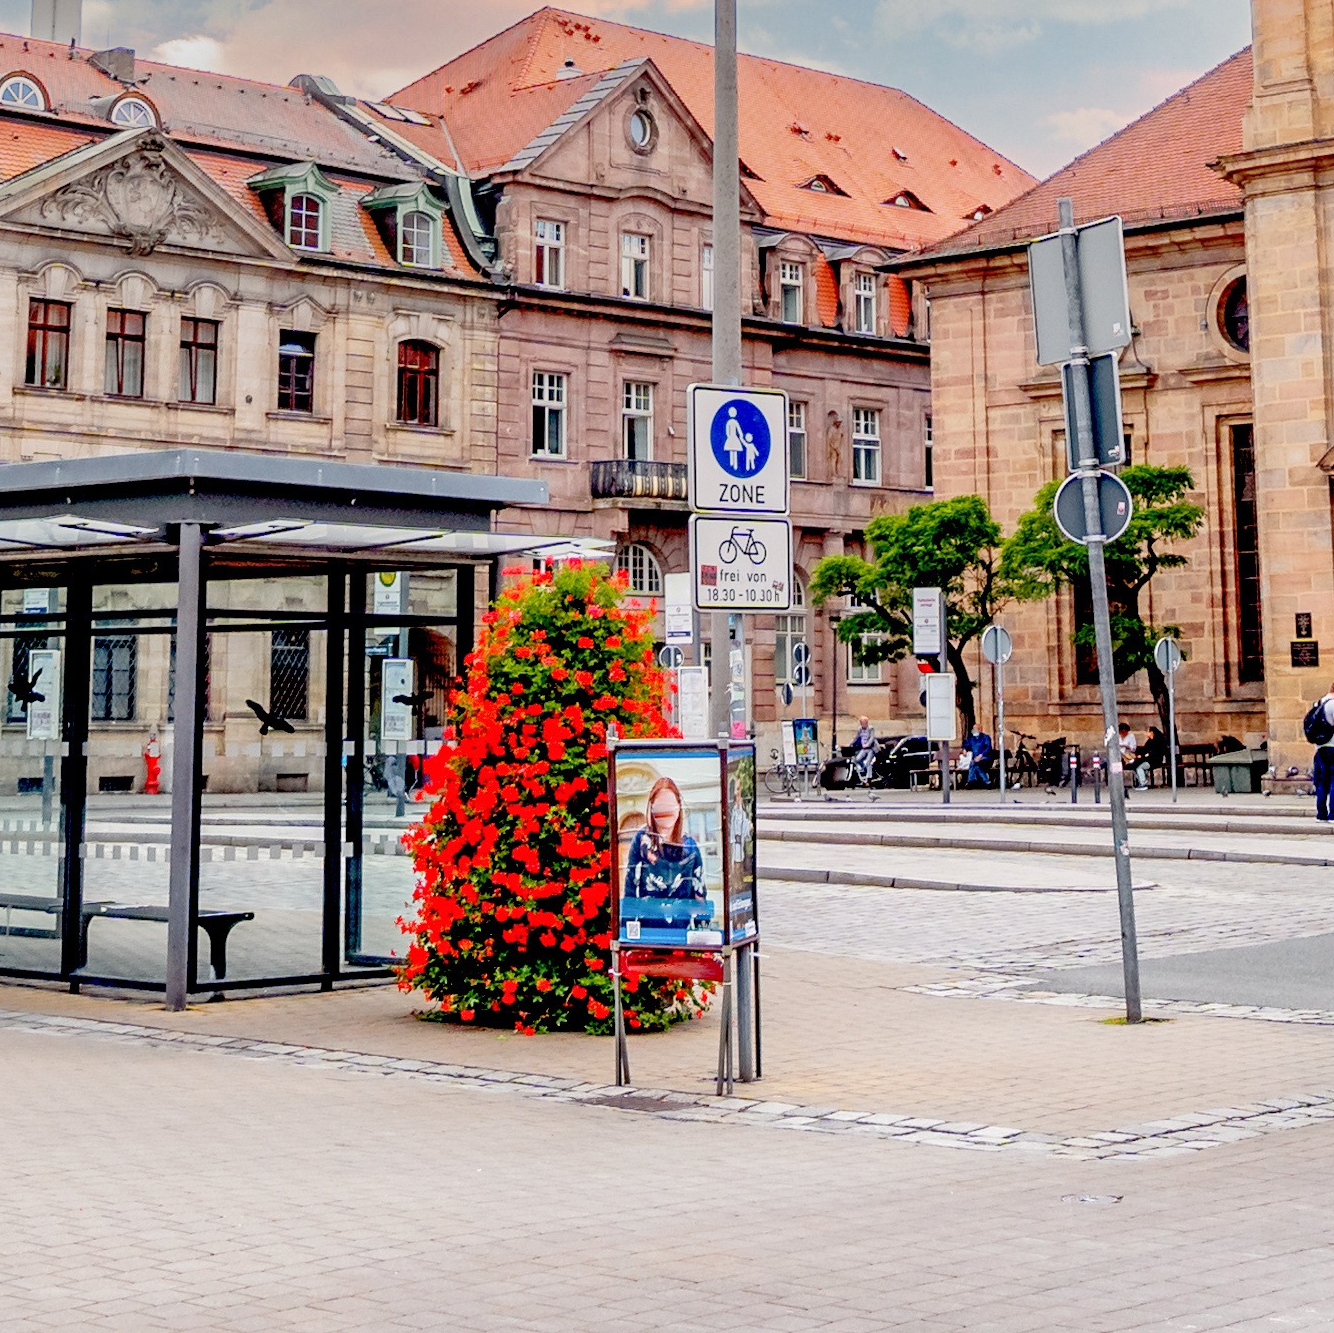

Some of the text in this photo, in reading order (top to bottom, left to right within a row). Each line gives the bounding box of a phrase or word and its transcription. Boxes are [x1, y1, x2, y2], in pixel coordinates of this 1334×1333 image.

[719, 483, 765, 504] ZONE
[720, 569, 740, 582] frei
[747, 572, 767, 583] von
